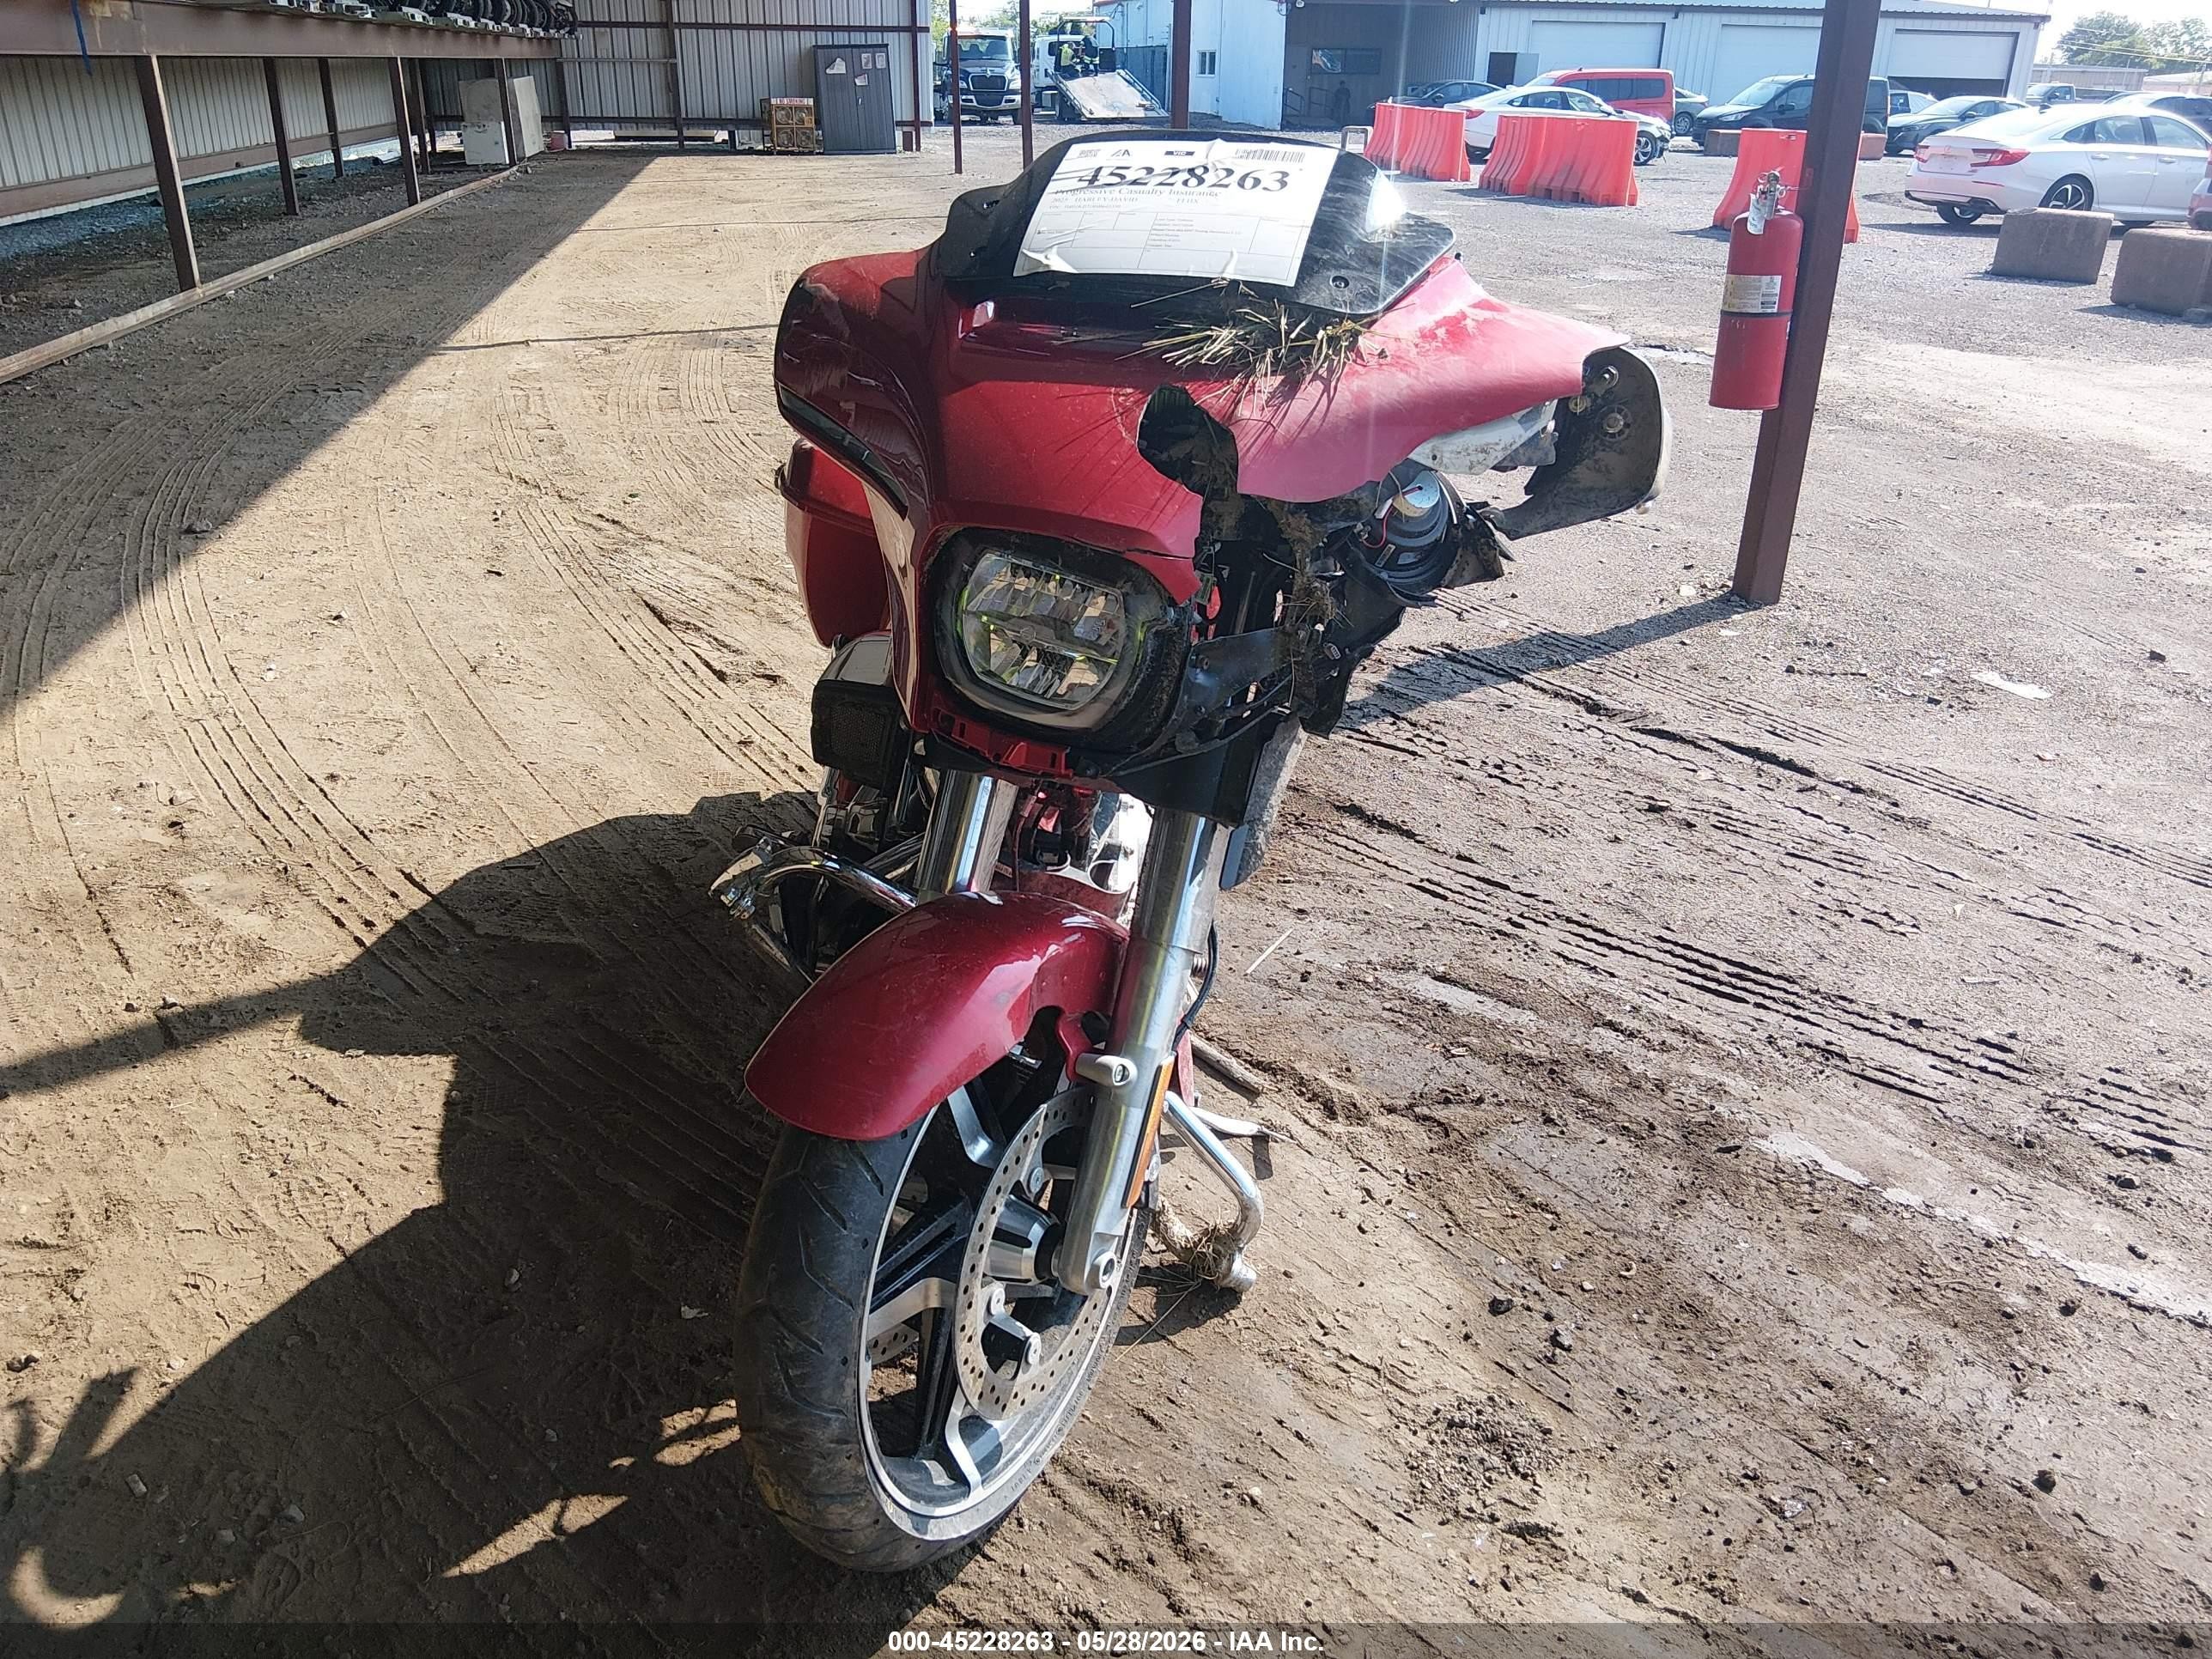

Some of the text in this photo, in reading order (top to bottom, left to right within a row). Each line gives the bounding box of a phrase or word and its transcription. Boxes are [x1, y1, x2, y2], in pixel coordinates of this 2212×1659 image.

[1077, 165, 1290, 191] 45228263
[1118, 188, 1164, 197] Casualty
[1169, 188, 1221, 198] Insurance
